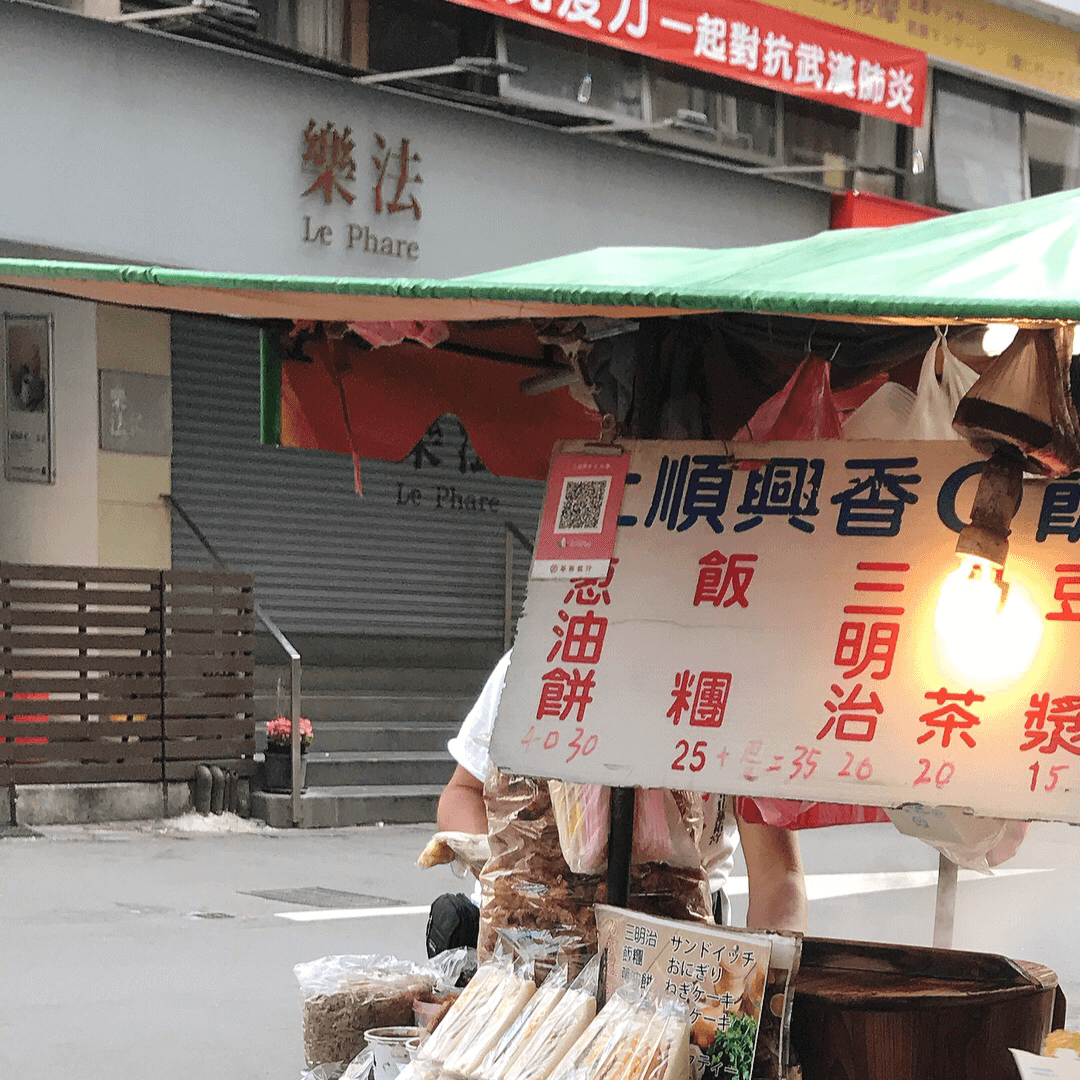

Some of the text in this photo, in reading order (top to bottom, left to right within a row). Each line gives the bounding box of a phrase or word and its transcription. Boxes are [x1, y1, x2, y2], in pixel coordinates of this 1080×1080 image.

[503, 0, 916, 114] 疫力一起對抗武漢肺炎
[301, 118, 422, 221] 樂法
[303, 215, 420, 261] Le Phare
[396, 481, 500, 513] Le Phare
[666, 549, 759, 727] 飯糰
[816, 561, 911, 742] 三明治
[566, 727, 598, 763] 30
[913, 757, 955, 789] 20
[1028, 760, 1070, 792] 15
[624, 922, 658, 948] 三明治
[670, 935, 755, 968] サンドイッチ
[666, 957, 723, 985] おにぎり
